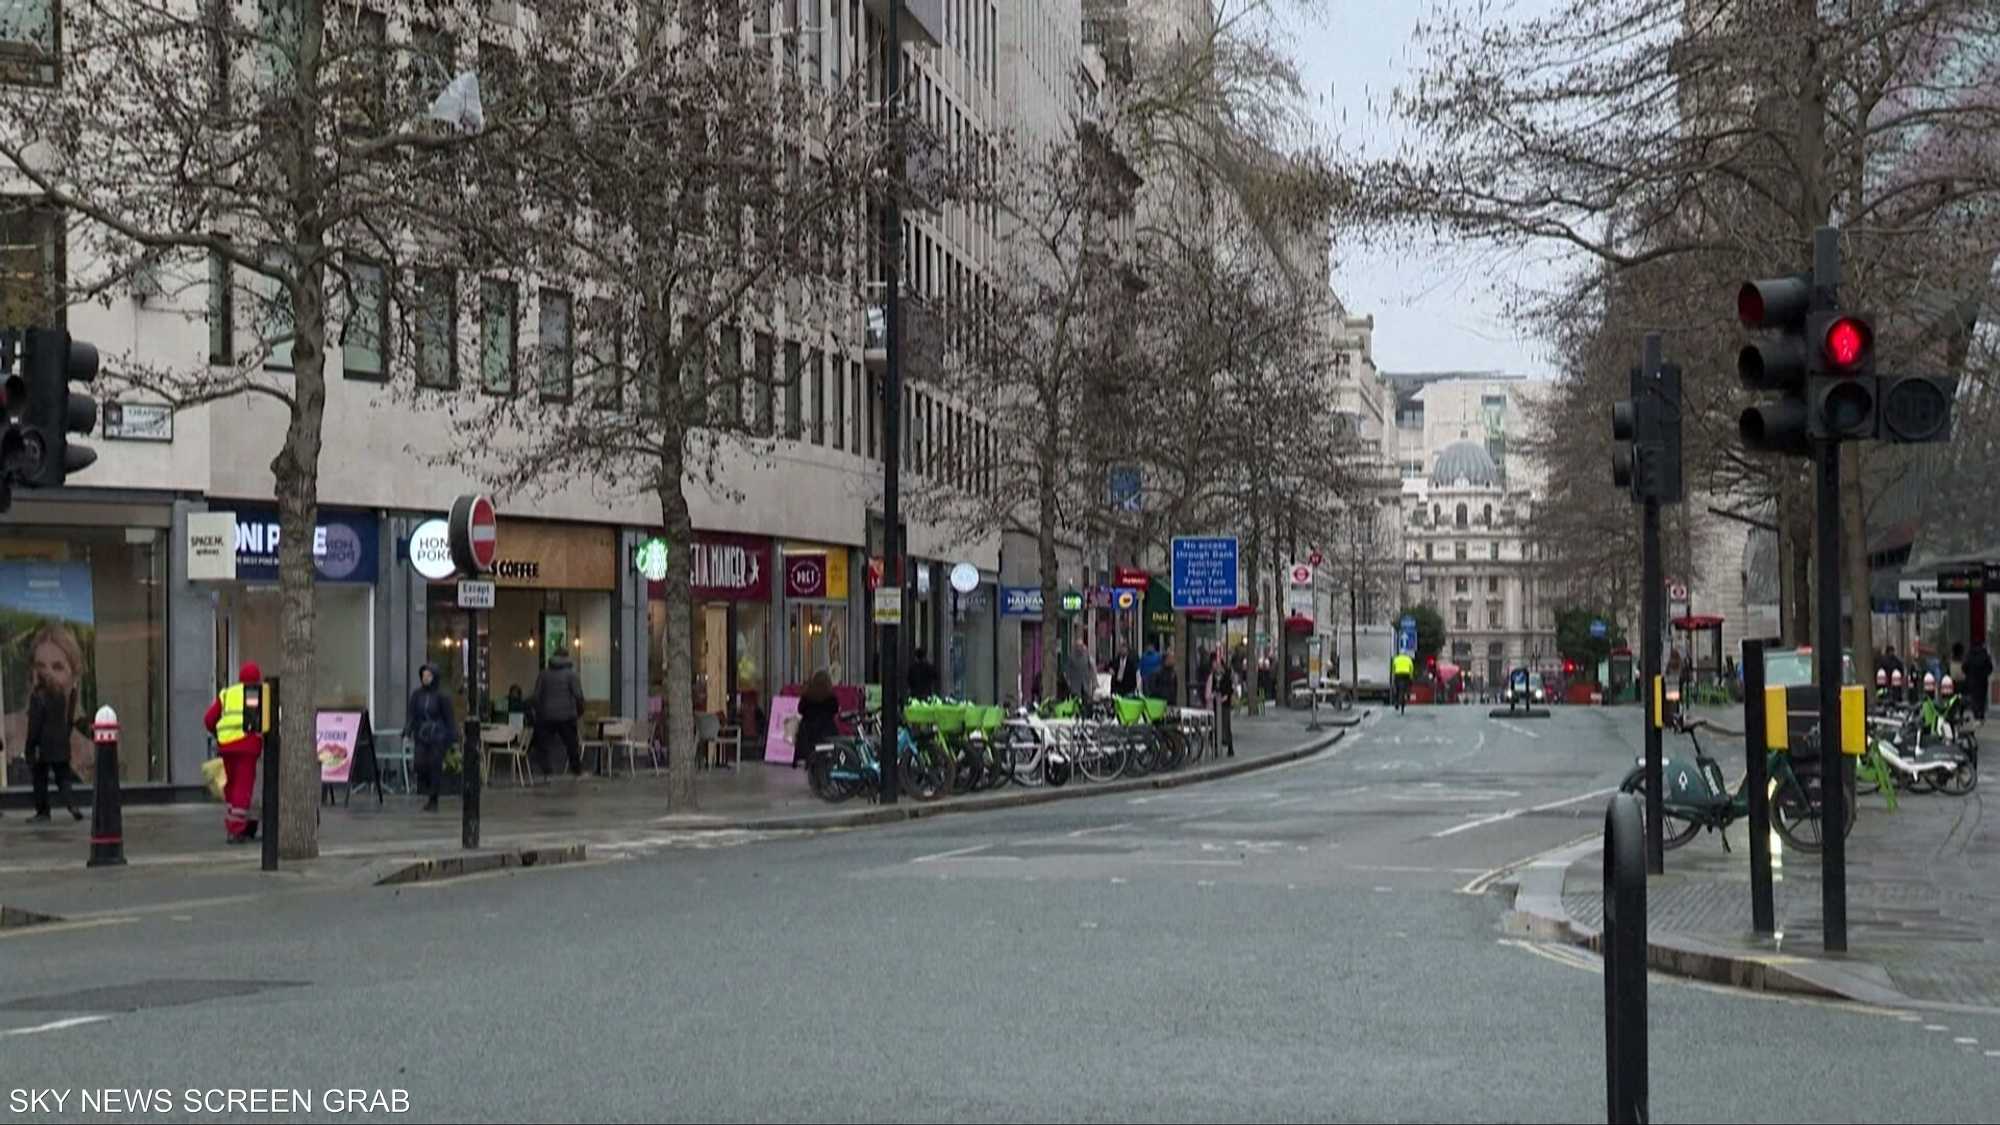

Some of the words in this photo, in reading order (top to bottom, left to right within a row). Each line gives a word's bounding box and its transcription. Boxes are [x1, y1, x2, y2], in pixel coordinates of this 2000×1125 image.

[419, 537, 449, 549] HON
[499, 560, 539, 578] COFFEE
[463, 583, 489, 595] Except
[464, 594, 489, 606] cycles
